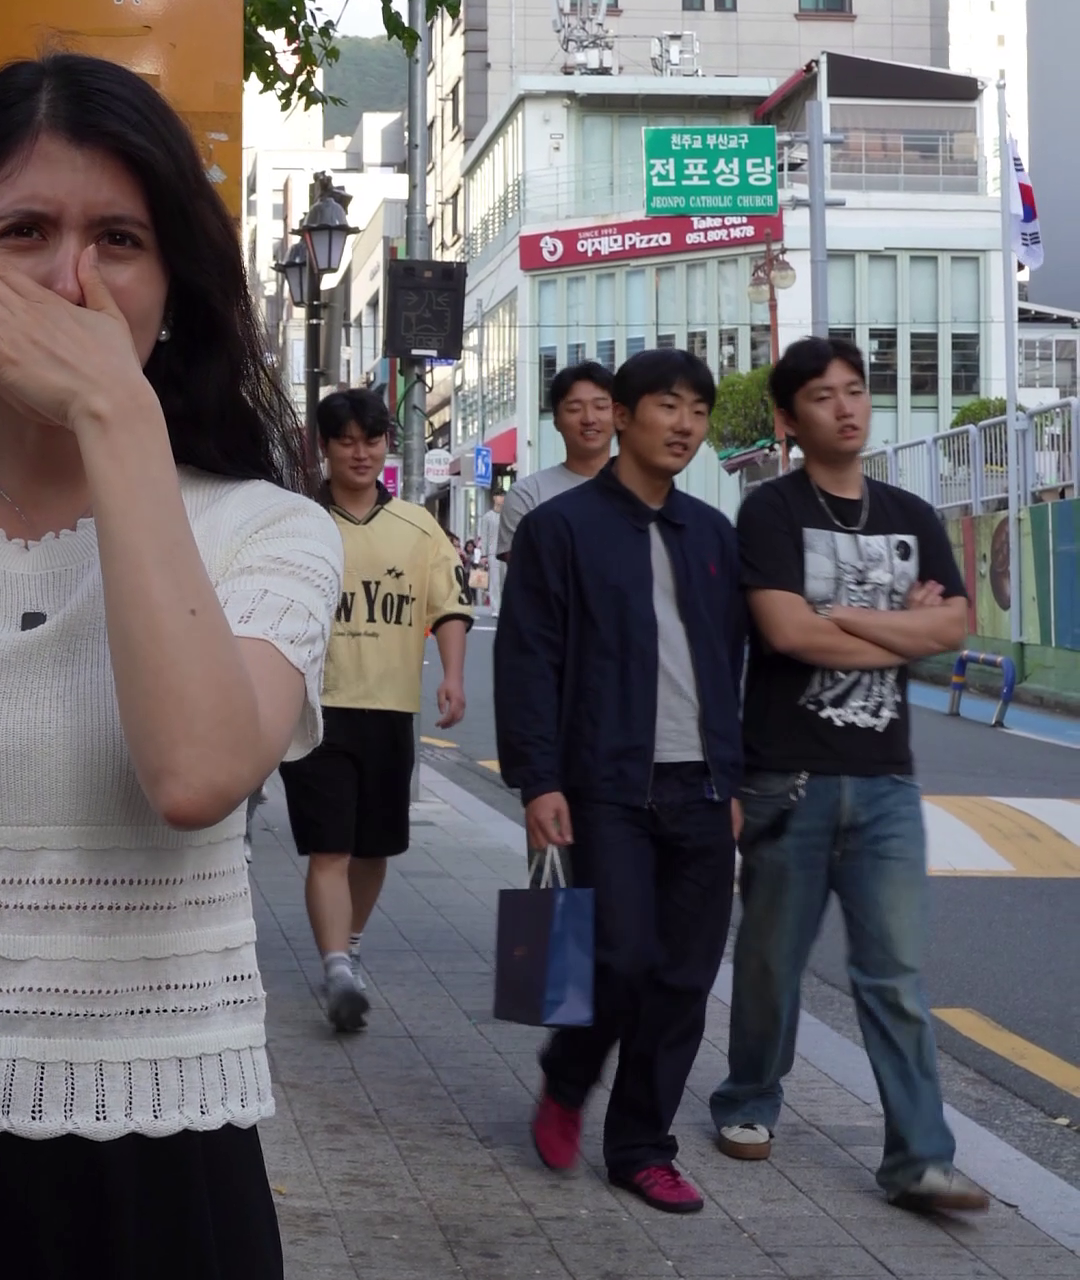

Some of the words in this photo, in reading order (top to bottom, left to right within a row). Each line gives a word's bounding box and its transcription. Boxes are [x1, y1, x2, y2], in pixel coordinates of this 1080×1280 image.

[670, 133, 703, 150] 천주교
[706, 133, 749, 150] 부산교구
[649, 156, 775, 187] 전포성당
[650, 195, 686, 209] JEONPO
[689, 195, 733, 208] CATHOLIC
[737, 194, 774, 207] CHURCH
[577, 229, 600, 239] SINCE
